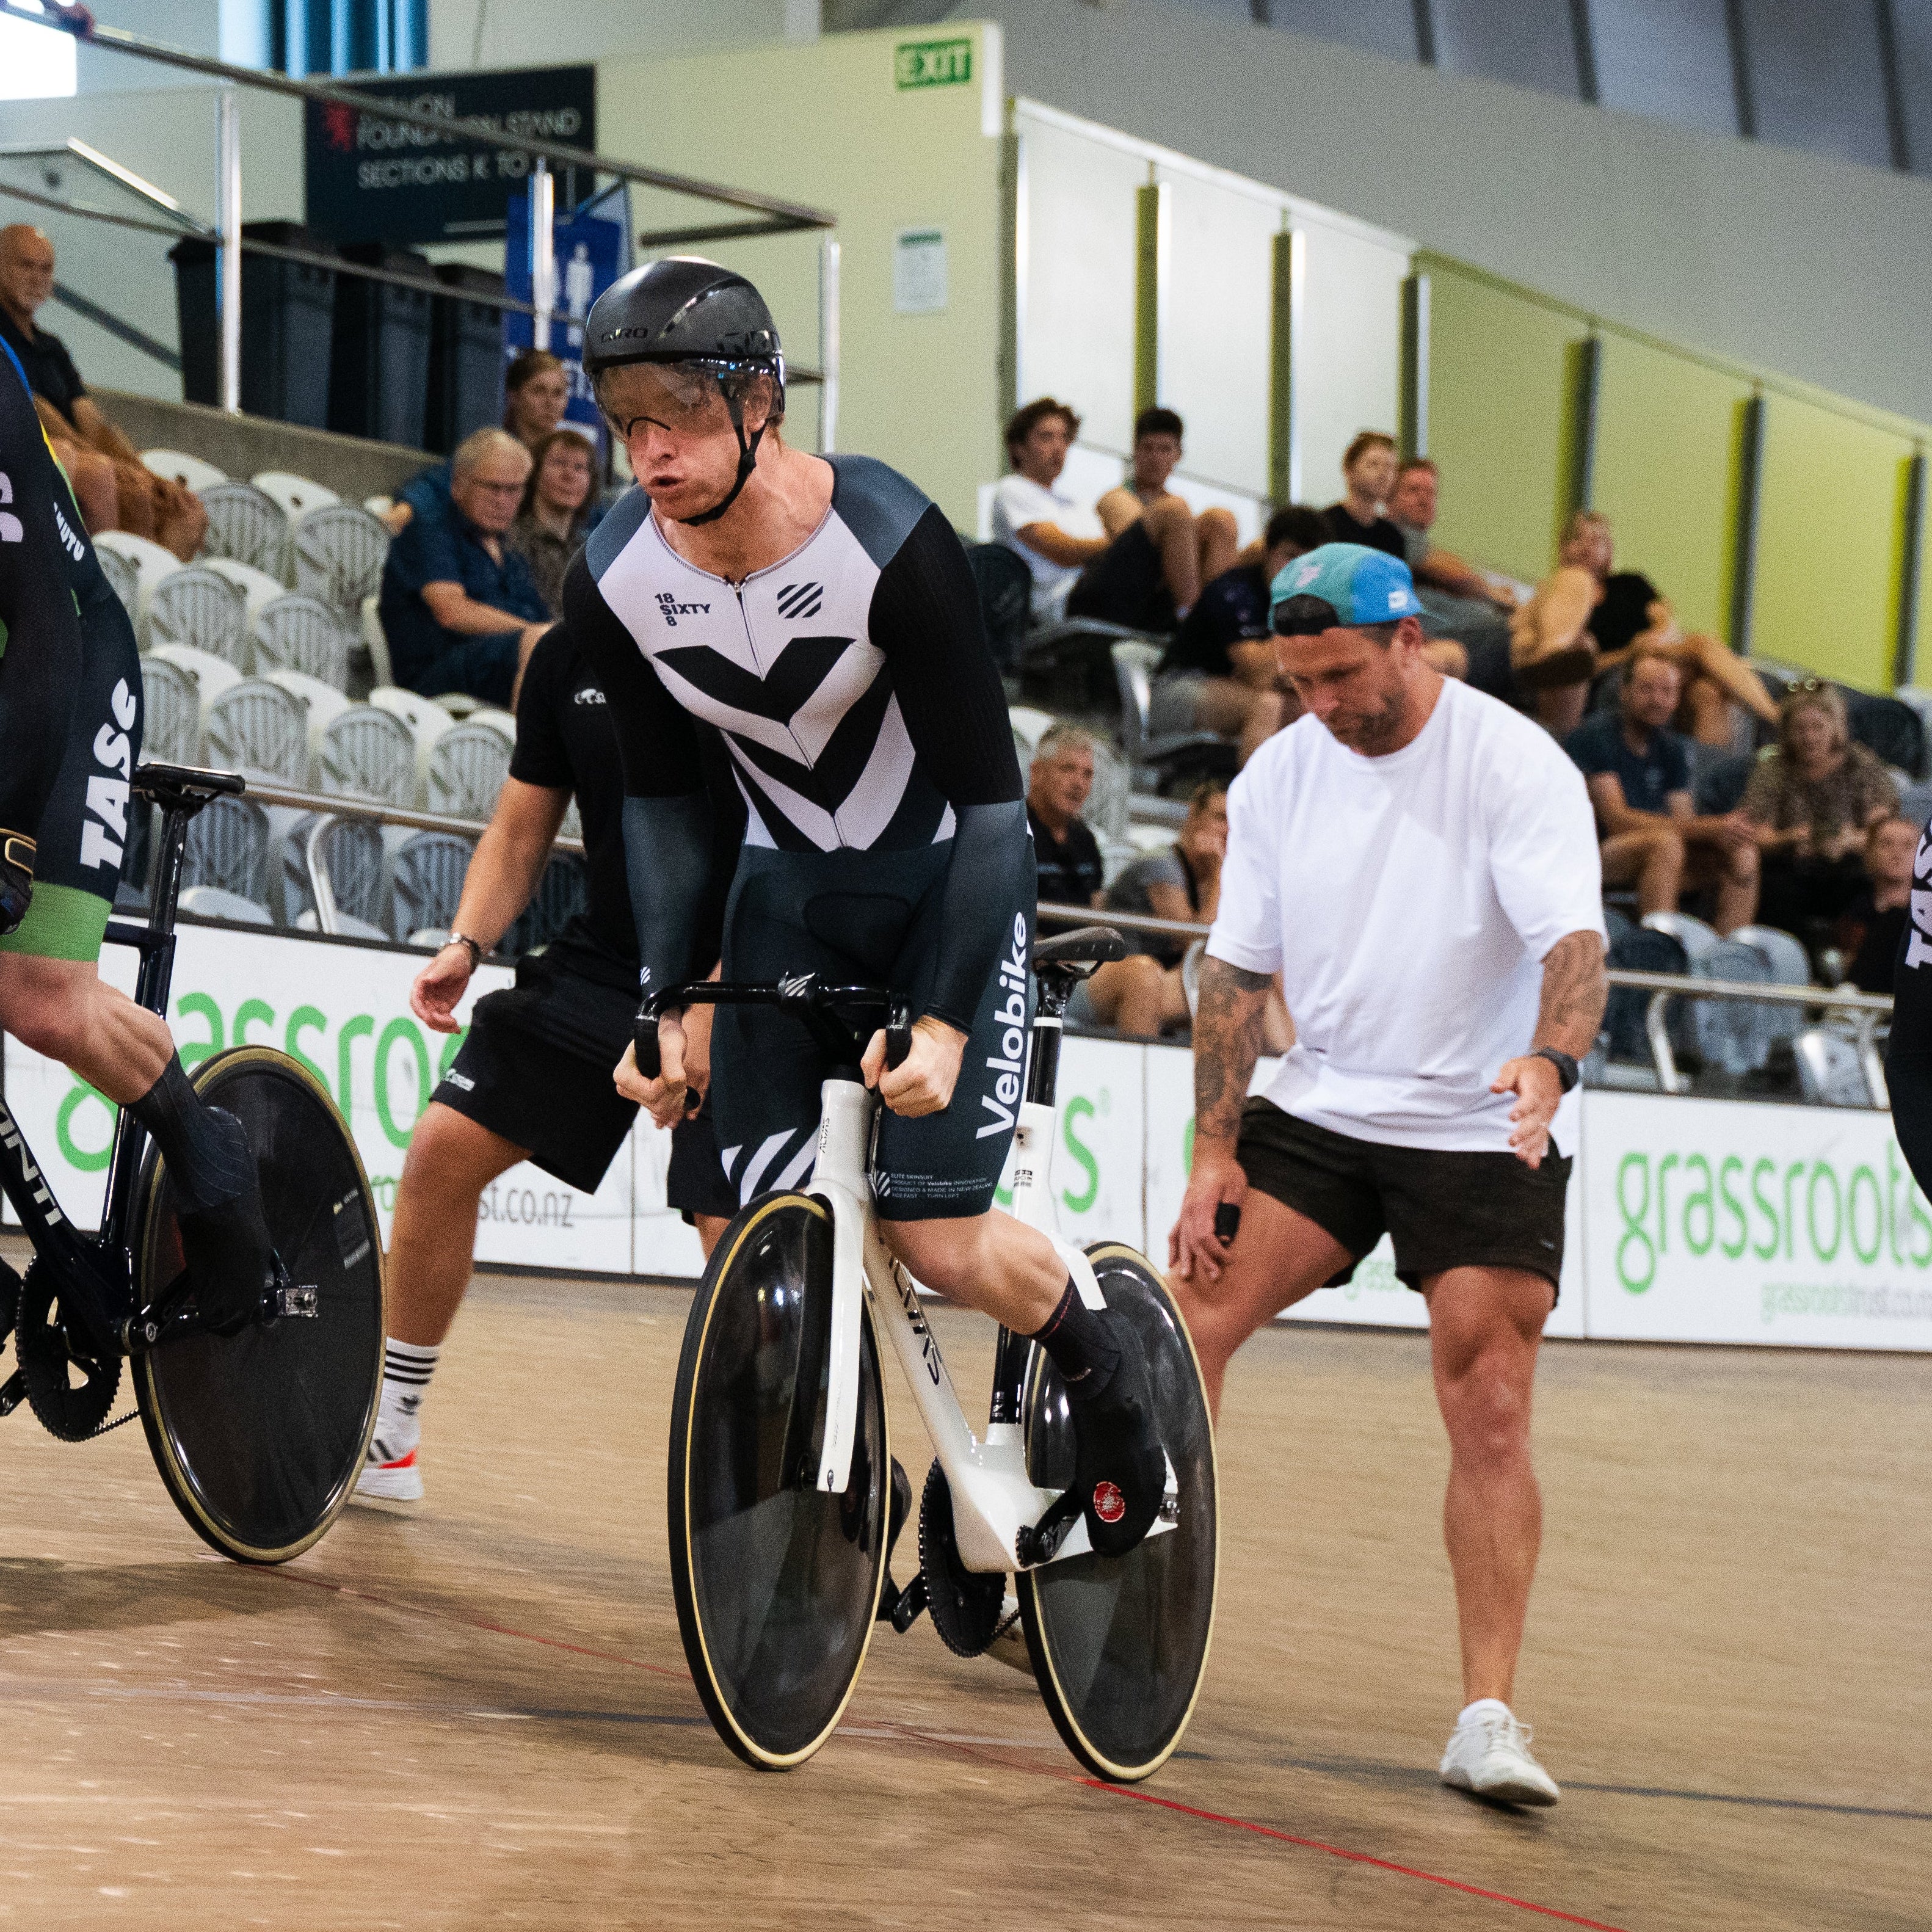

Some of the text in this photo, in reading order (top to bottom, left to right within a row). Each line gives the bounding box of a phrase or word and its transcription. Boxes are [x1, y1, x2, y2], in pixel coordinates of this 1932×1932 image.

[898, 45, 968, 84] EXIT
[357, 159, 470, 189] SECTIONS
[655, 592, 675, 604] 18
[659, 603, 711, 615] SIXTY
[666, 616, 677, 626] 8
[976, 912, 1026, 1139] Velobike
[1616, 1139, 1932, 1295] grassroots
